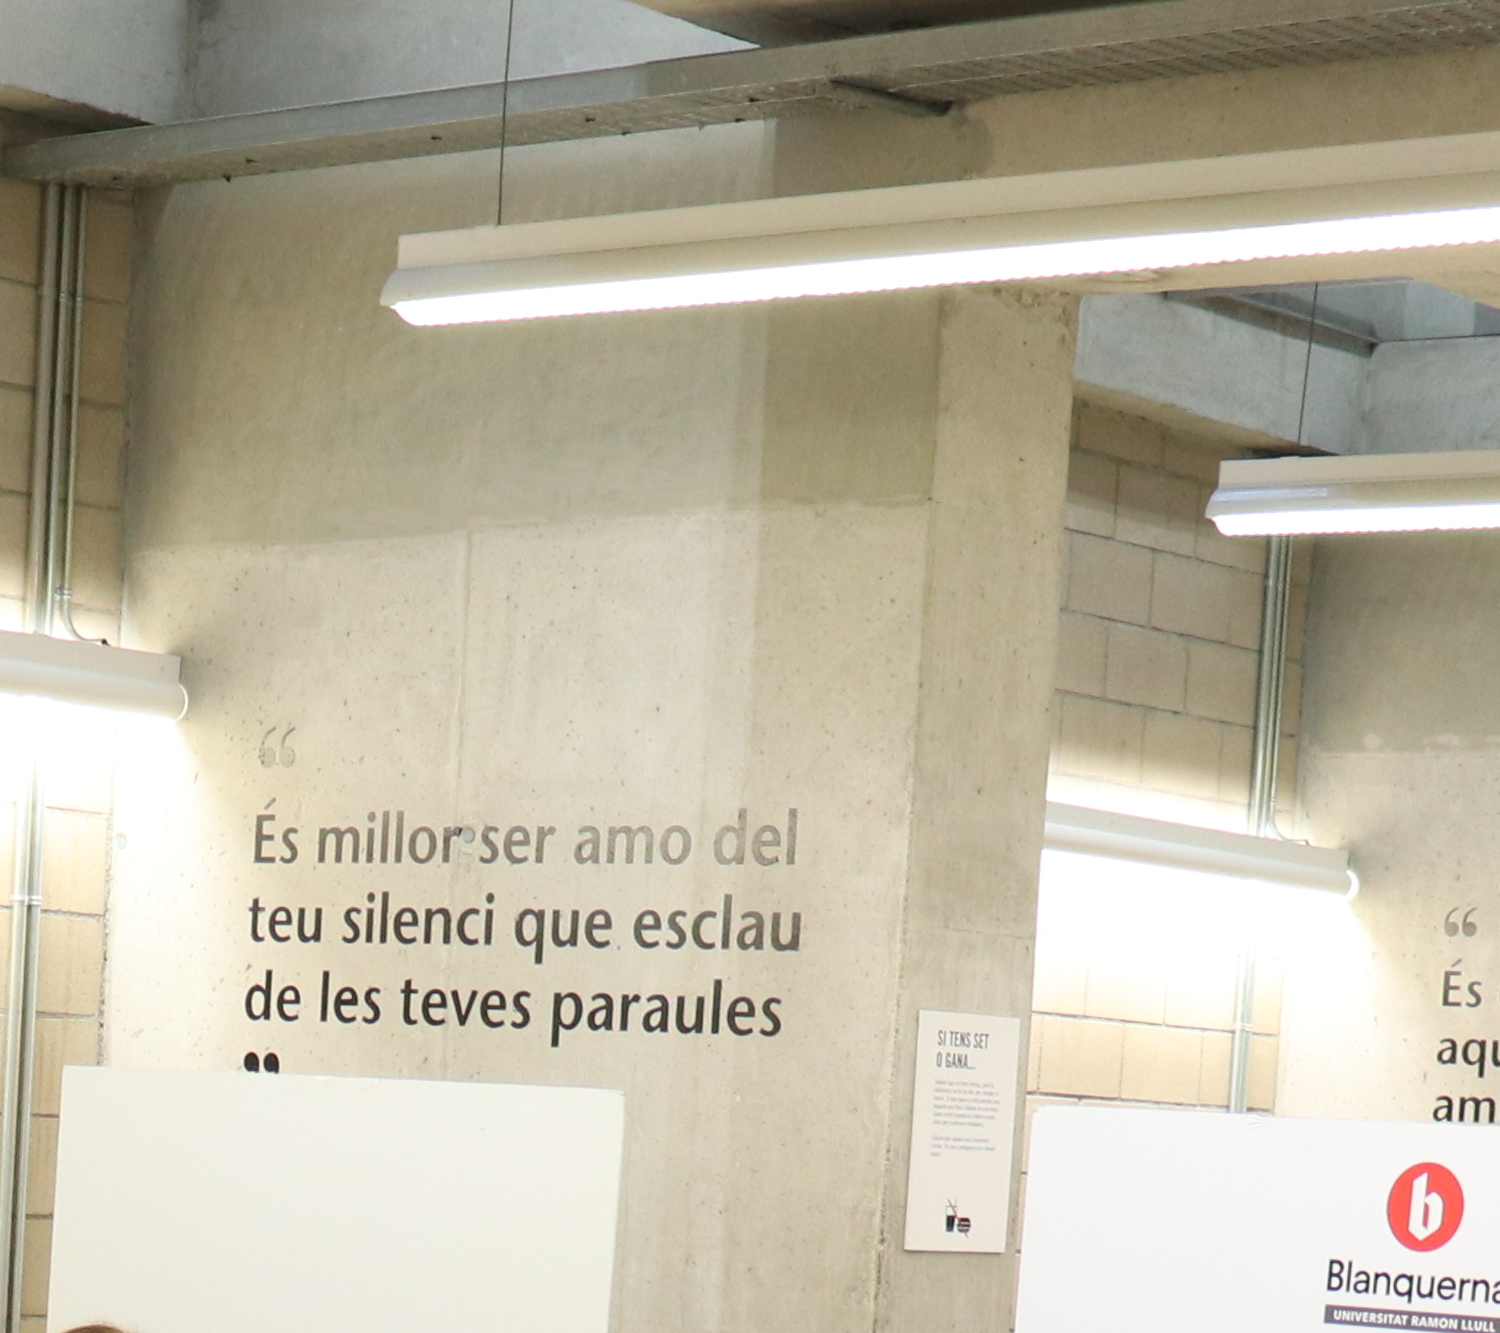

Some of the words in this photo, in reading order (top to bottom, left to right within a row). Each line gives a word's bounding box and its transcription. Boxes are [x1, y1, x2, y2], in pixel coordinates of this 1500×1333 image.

[253, 797, 297, 866] És
[316, 810, 460, 867] millor
[480, 820, 555, 867] ser
[573, 823, 691, 867] amo
[713, 808, 799, 867] del
[248, 898, 323, 946] teu
[341, 892, 494, 946] silenci
[514, 905, 612, 964] que
[632, 895, 802, 952] esclau
[244, 970, 302, 1023] de
[319, 971, 381, 1025] les
[402, 978, 531, 1029] teves
[550, 979, 782, 1048] paraules
[1442, 959, 1482, 1009] És
[937, 1030, 946, 1046] SI
[949, 1031, 971, 1048] TENS
[973, 1033, 989, 1049] SET
[1333, 1309, 1408, 1326] UNIVERSITAT
[1411, 1315, 1458, 1330] RAMON
[1461, 1319, 1496, 1333] LLULL
